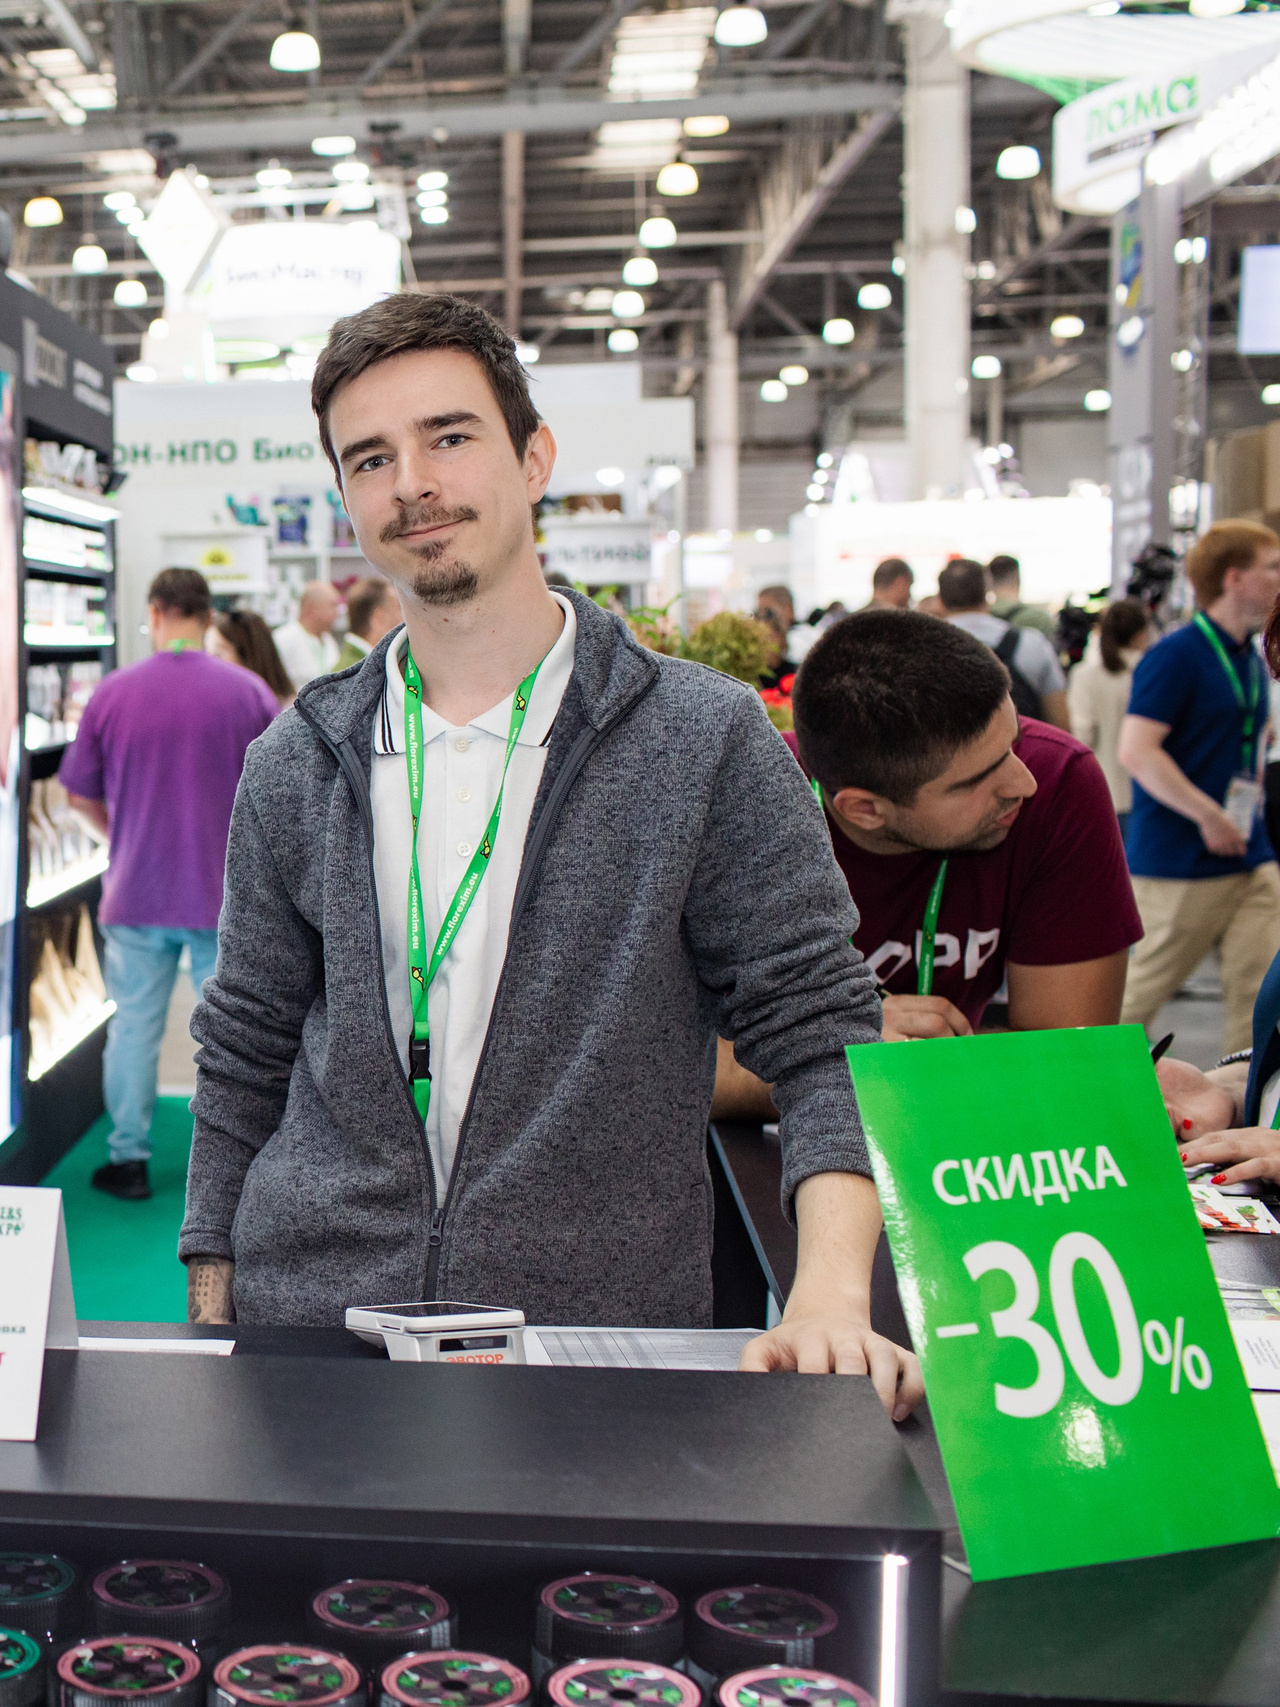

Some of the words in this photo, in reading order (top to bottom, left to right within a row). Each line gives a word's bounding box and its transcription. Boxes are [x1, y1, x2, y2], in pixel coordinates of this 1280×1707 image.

[253, 437, 320, 463] Био
[408, 713, 419, 799] www.florexim.eu
[436, 872, 478, 956] www.florexim.eu
[932, 1145, 1128, 1206] СКИДКА
